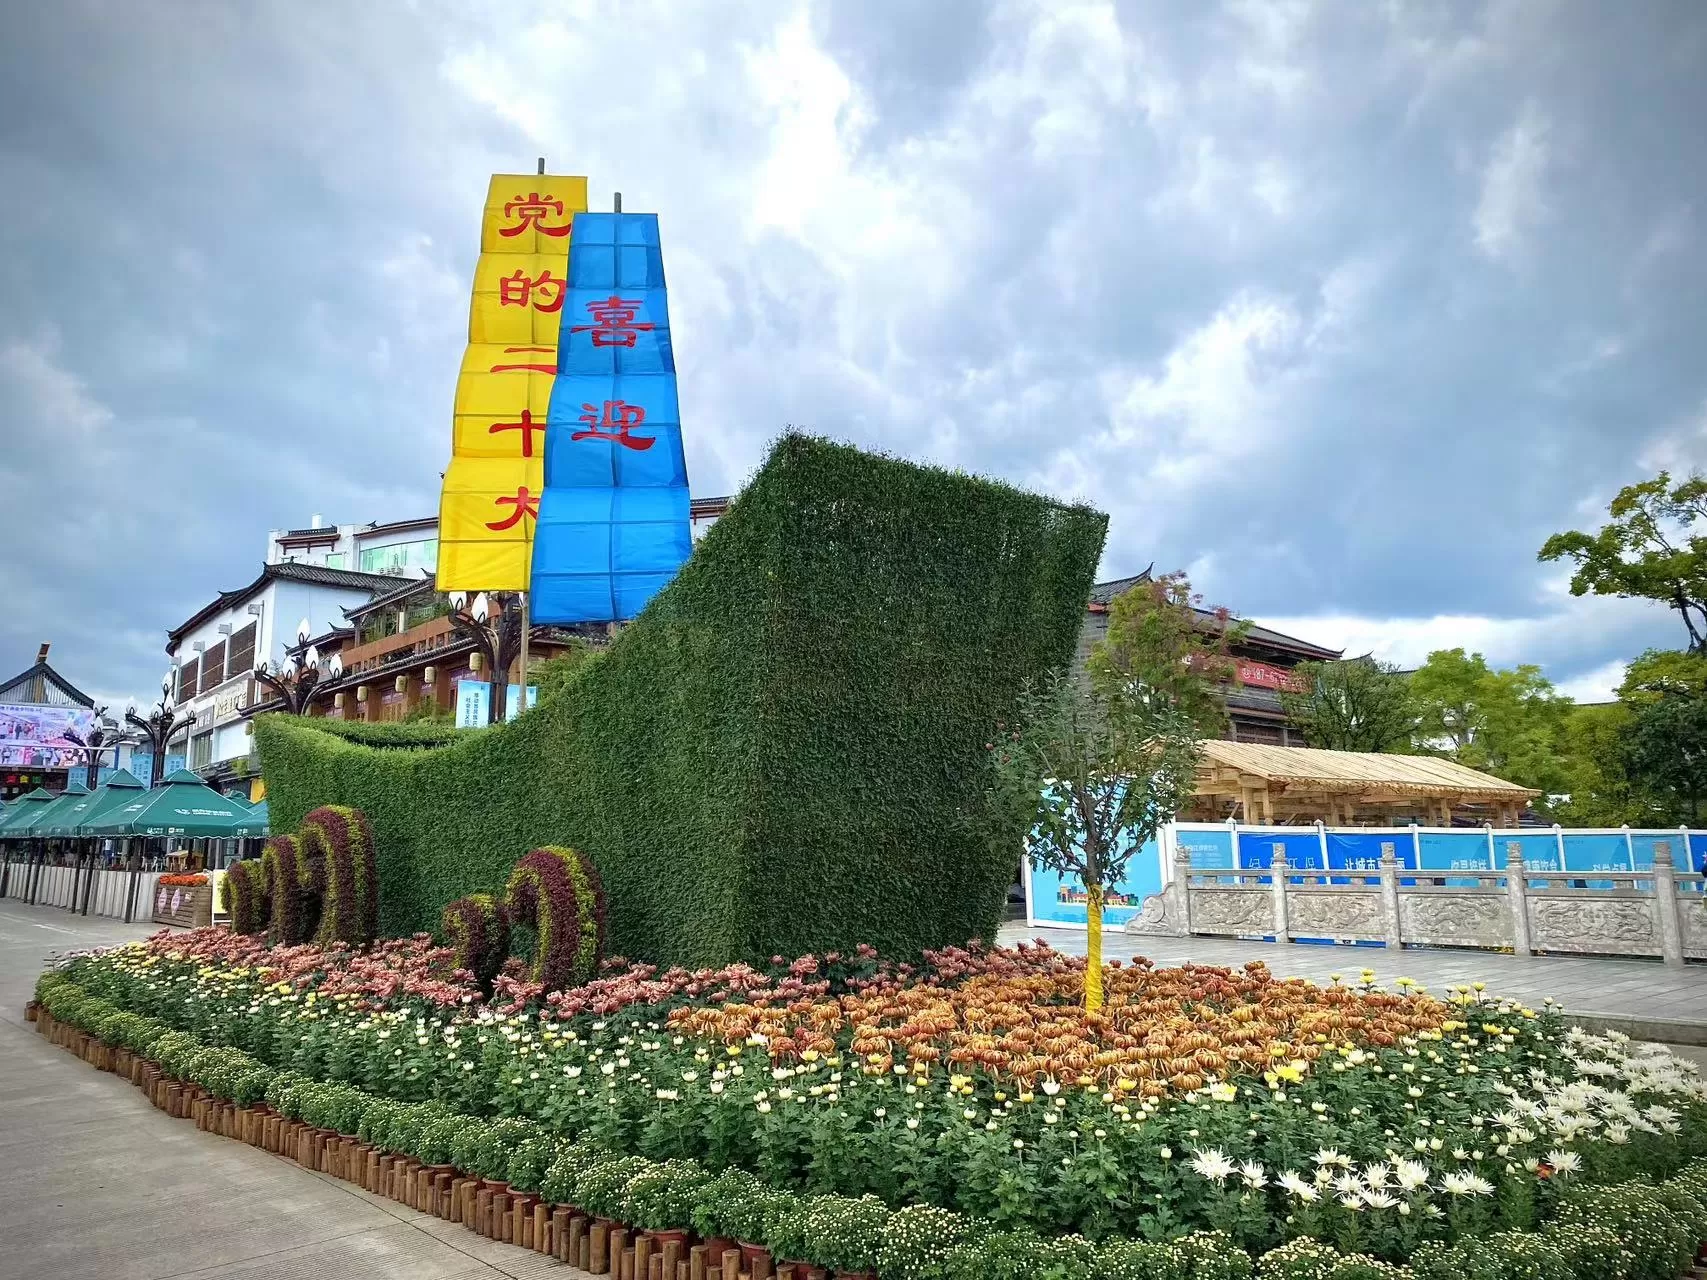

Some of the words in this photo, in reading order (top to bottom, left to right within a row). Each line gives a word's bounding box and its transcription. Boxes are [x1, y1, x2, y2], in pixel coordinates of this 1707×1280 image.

[485, 192, 572, 532] 党的二十大
[571, 295, 656, 451] 喜迎
